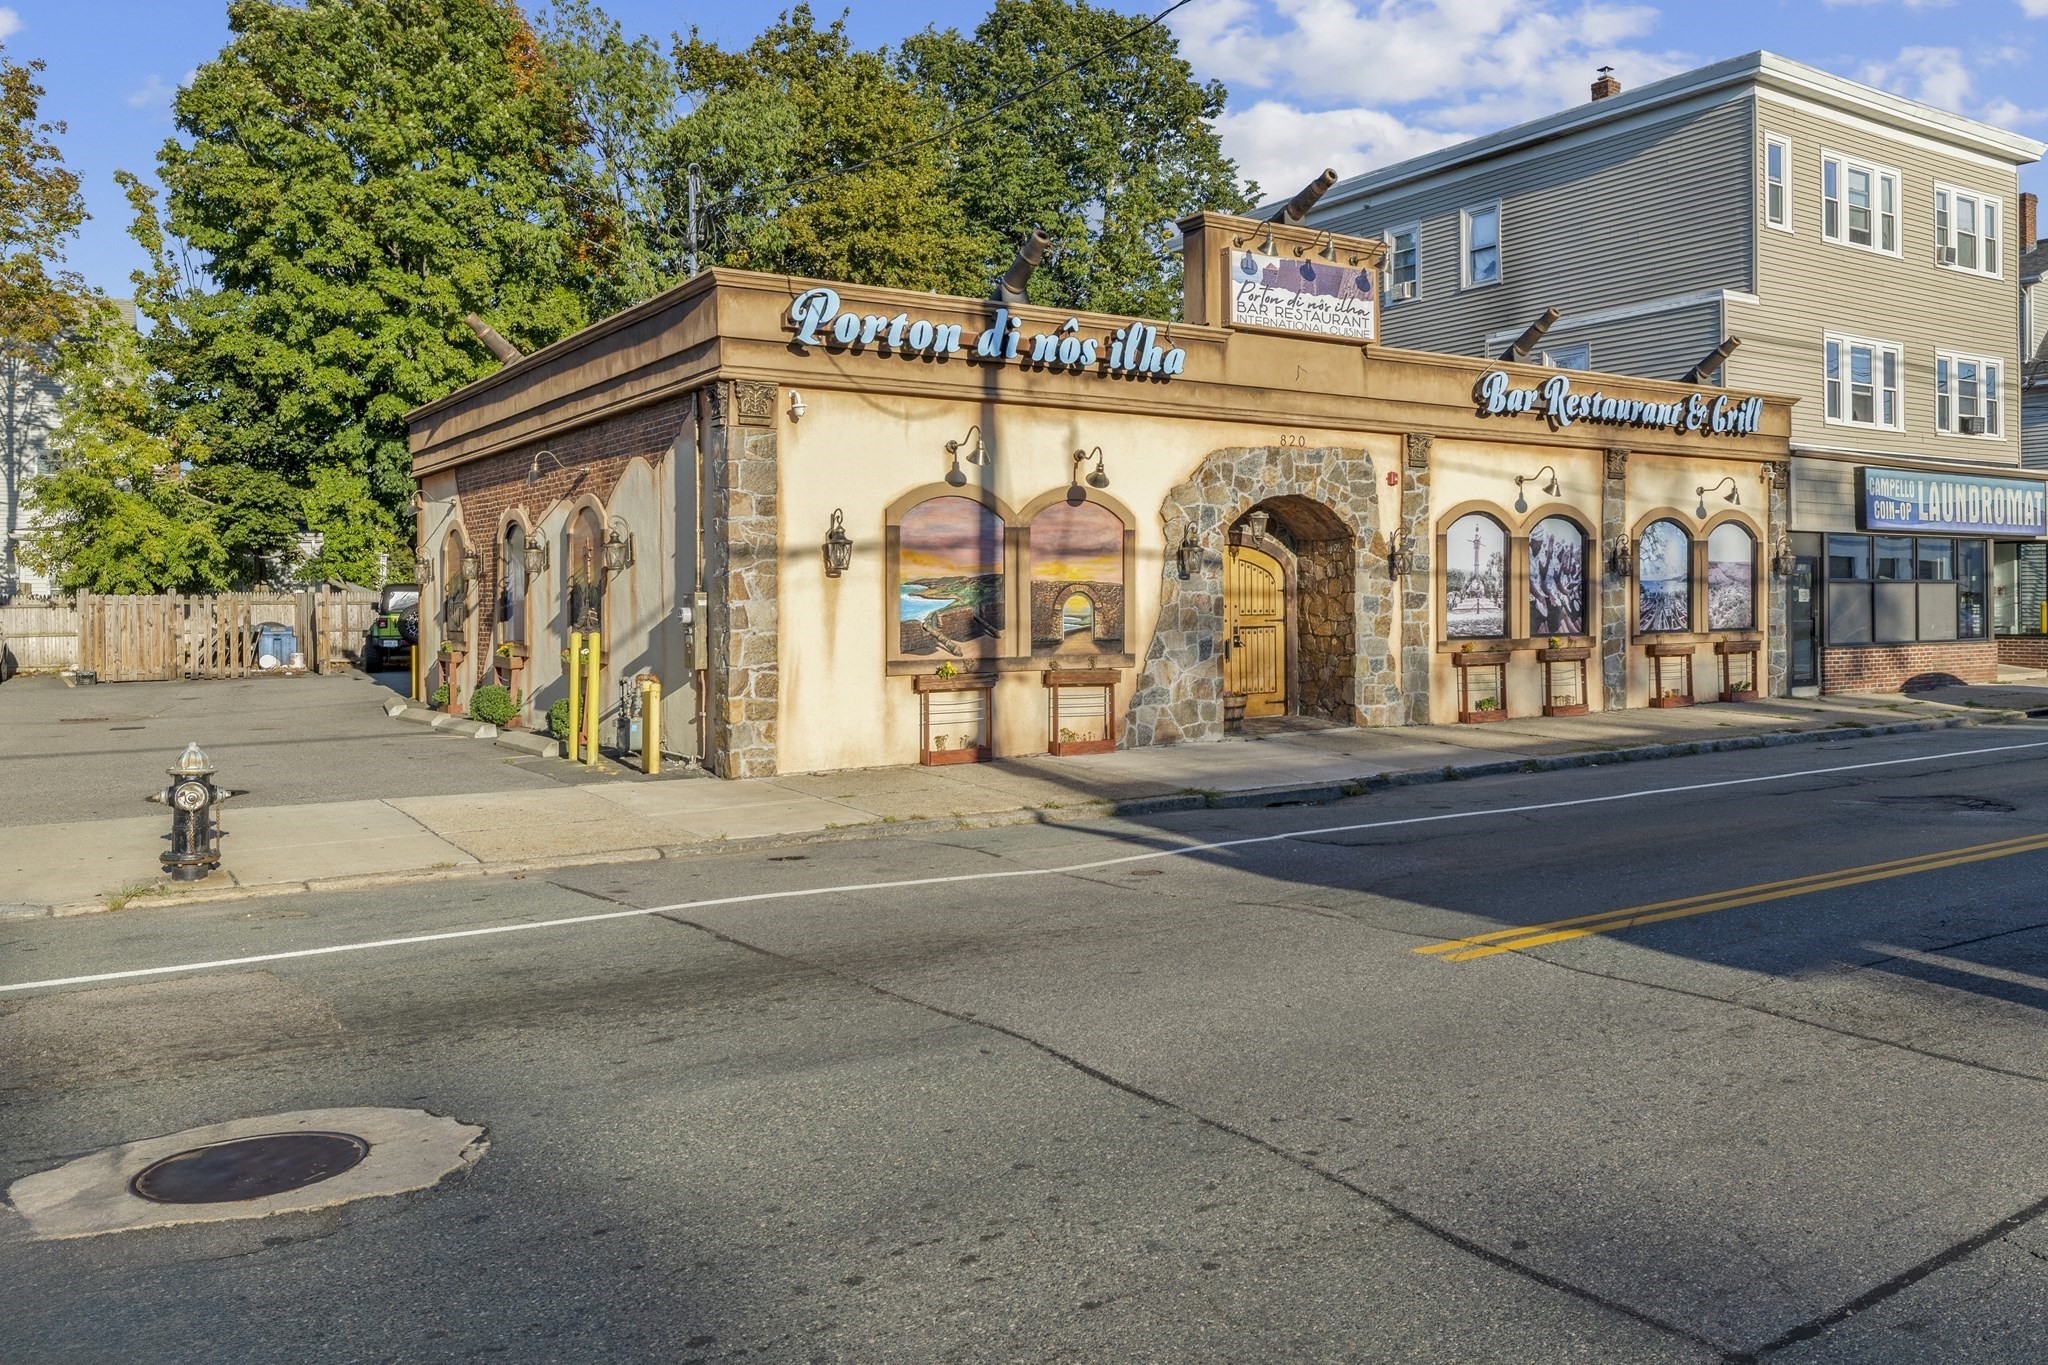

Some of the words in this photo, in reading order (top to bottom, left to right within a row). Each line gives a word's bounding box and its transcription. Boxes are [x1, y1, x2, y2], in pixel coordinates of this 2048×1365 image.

[1237, 280, 1284, 307] Porton
[1287, 289, 1304, 307] di
[1308, 299, 1331, 312] nôs
[1334, 293, 1370, 316] ilha
[1237, 302, 1268, 316] BAR
[1275, 306, 1370, 328] RESTAURANT
[1237, 314, 1327, 333] INTERNATIONAL
[1330, 326, 1370, 338] CUISINE
[791, 287, 962, 353] Porton
[977, 308, 1022, 359] di
[1031, 317, 1097, 366] nôs
[1110, 321, 1186, 375] ilha
[1482, 371, 1539, 413] Bar
[1544, 375, 1683, 427] Restaurant
[1686, 393, 1708, 431] &
[1712, 395, 1763, 432] Grill
[1280, 434, 1305, 447] 820
[1869, 477, 1915, 498] CAMPELLO
[1873, 500, 1912, 521] COIN-OP
[1917, 480, 2043, 527] LAUNDROMAT
